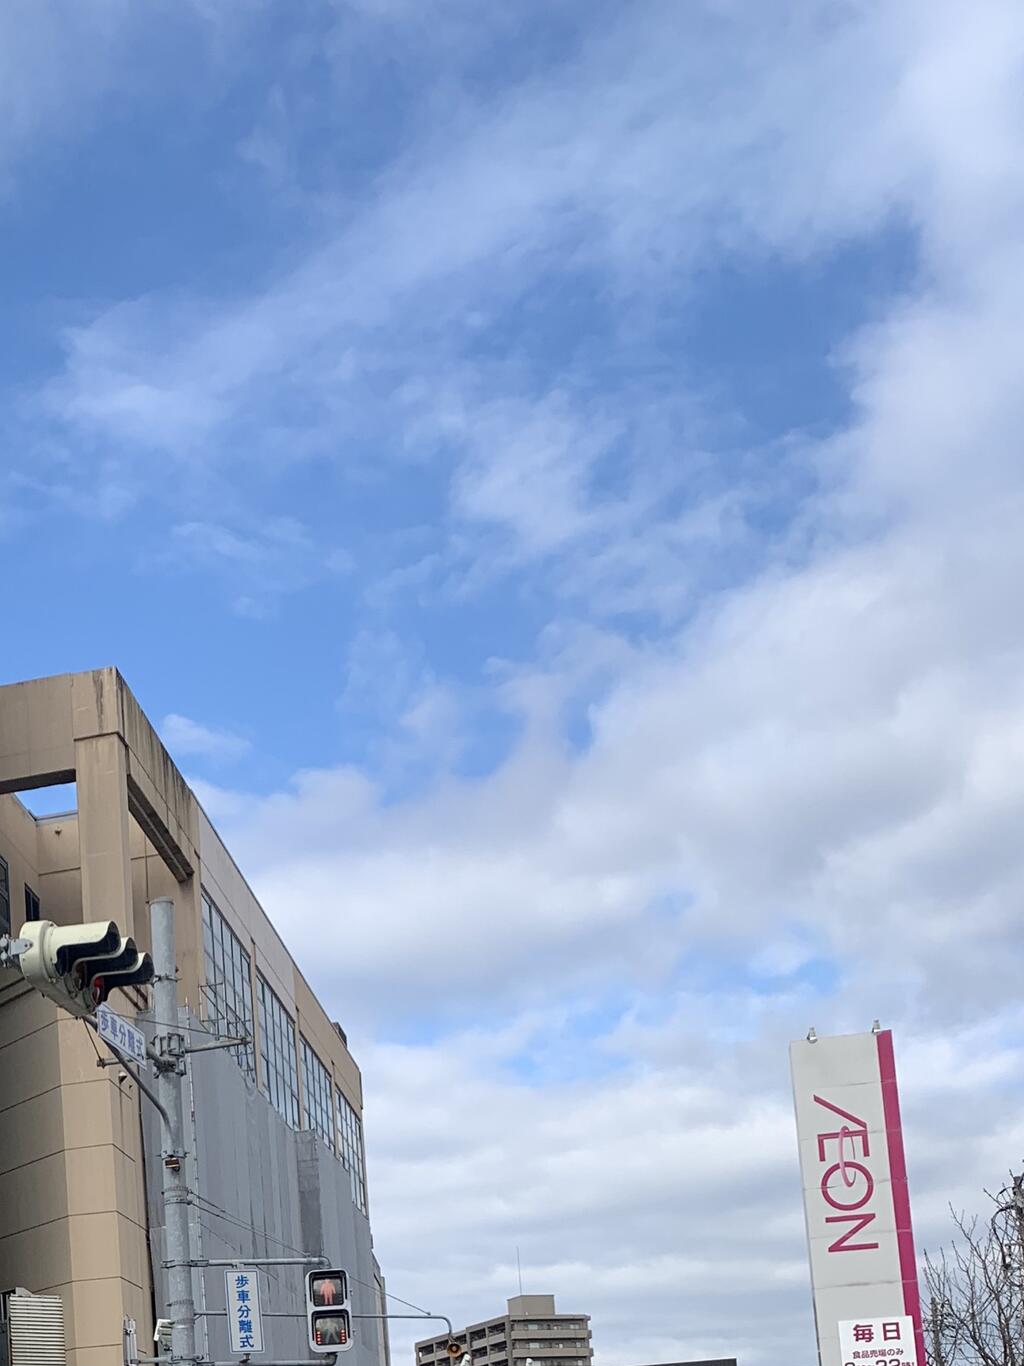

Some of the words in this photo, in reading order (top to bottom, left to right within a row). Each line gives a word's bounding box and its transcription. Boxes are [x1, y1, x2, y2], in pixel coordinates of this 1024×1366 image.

[235, 1274, 255, 1349] 歩車分離式
[852, 1322, 901, 1343] 毎日
[852, 1348, 904, 1359] 食品売場のみ
